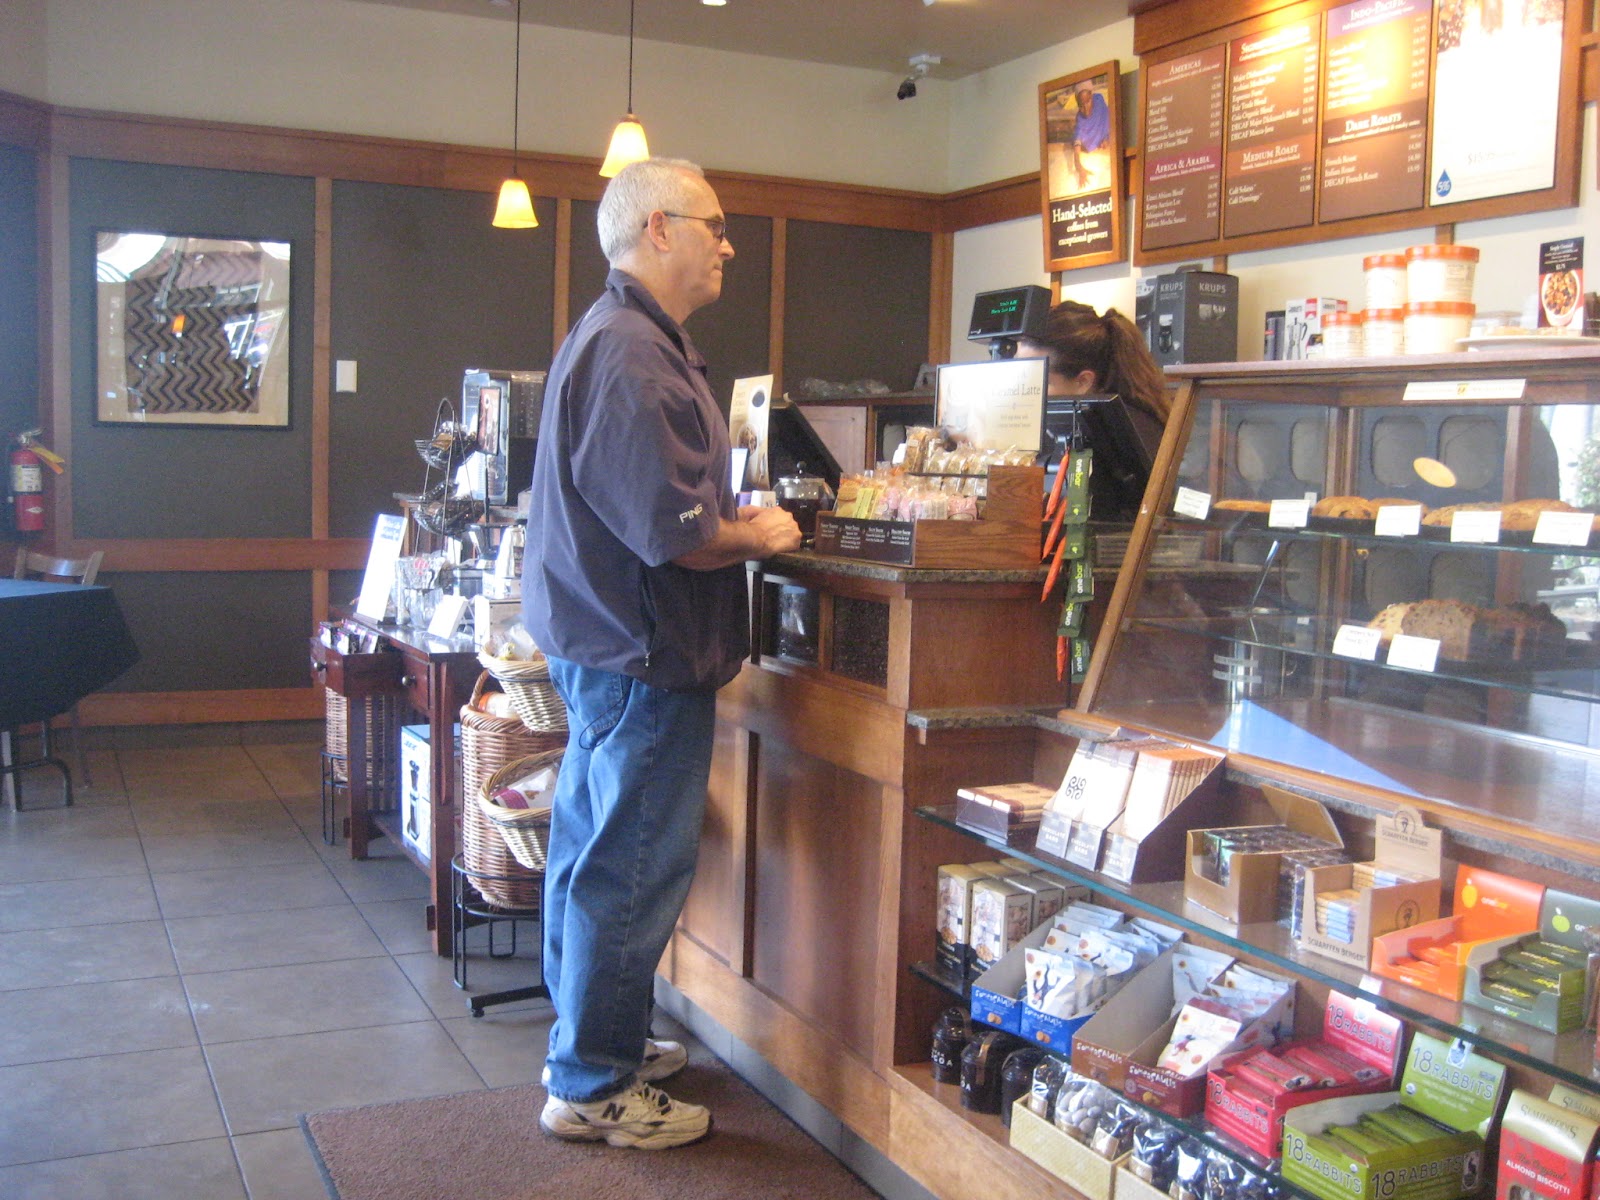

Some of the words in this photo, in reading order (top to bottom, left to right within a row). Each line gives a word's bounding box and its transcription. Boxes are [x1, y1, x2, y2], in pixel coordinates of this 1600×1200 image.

[1169, 59, 1201, 76] AMERICAS
[1243, 151, 1274, 164] MEDIUM
[1275, 144, 1299, 158] ROAST
[1155, 163, 1177, 174] AFRICA
[1178, 160, 1185, 169] &
[1186, 156, 1210, 167] ARABIA
[1324, 177, 1345, 188] DECAF
[1053, 196, 1112, 223] Hand-Selected
[1160, 282, 1183, 292] KRUPS
[1199, 283, 1227, 293] KRUPS
[1021, 383, 1041, 396] Latte
[679, 503, 703, 523] PING
[1075, 562, 1084, 594] onebar
[1075, 643, 1083, 673] onebar
[1041, 825, 1066, 838] CHOCOLATE
[1071, 838, 1095, 851] CHOCOLATE
[1074, 846, 1088, 856] BARS
[1340, 948, 1366, 961] BERGER
[1328, 1004, 1345, 1030] 18
[1343, 1018, 1392, 1053] RABBITS
[1412, 1046, 1433, 1073] 18
[1432, 1063, 1494, 1099] RABBITS
[602, 1102, 626, 1122] N
[1208, 1079, 1223, 1106] 18
[1222, 1095, 1269, 1134] RABBITS
[1286, 1134, 1304, 1162] 18
[1304, 1152, 1362, 1194] RABBITS
[1371, 1171, 1397, 1198] 18
[1399, 1154, 1463, 1183] RABBITS
[1505, 1159, 1536, 1179] ALMOND
[1536, 1174, 1570, 1195] BISCOTTI
